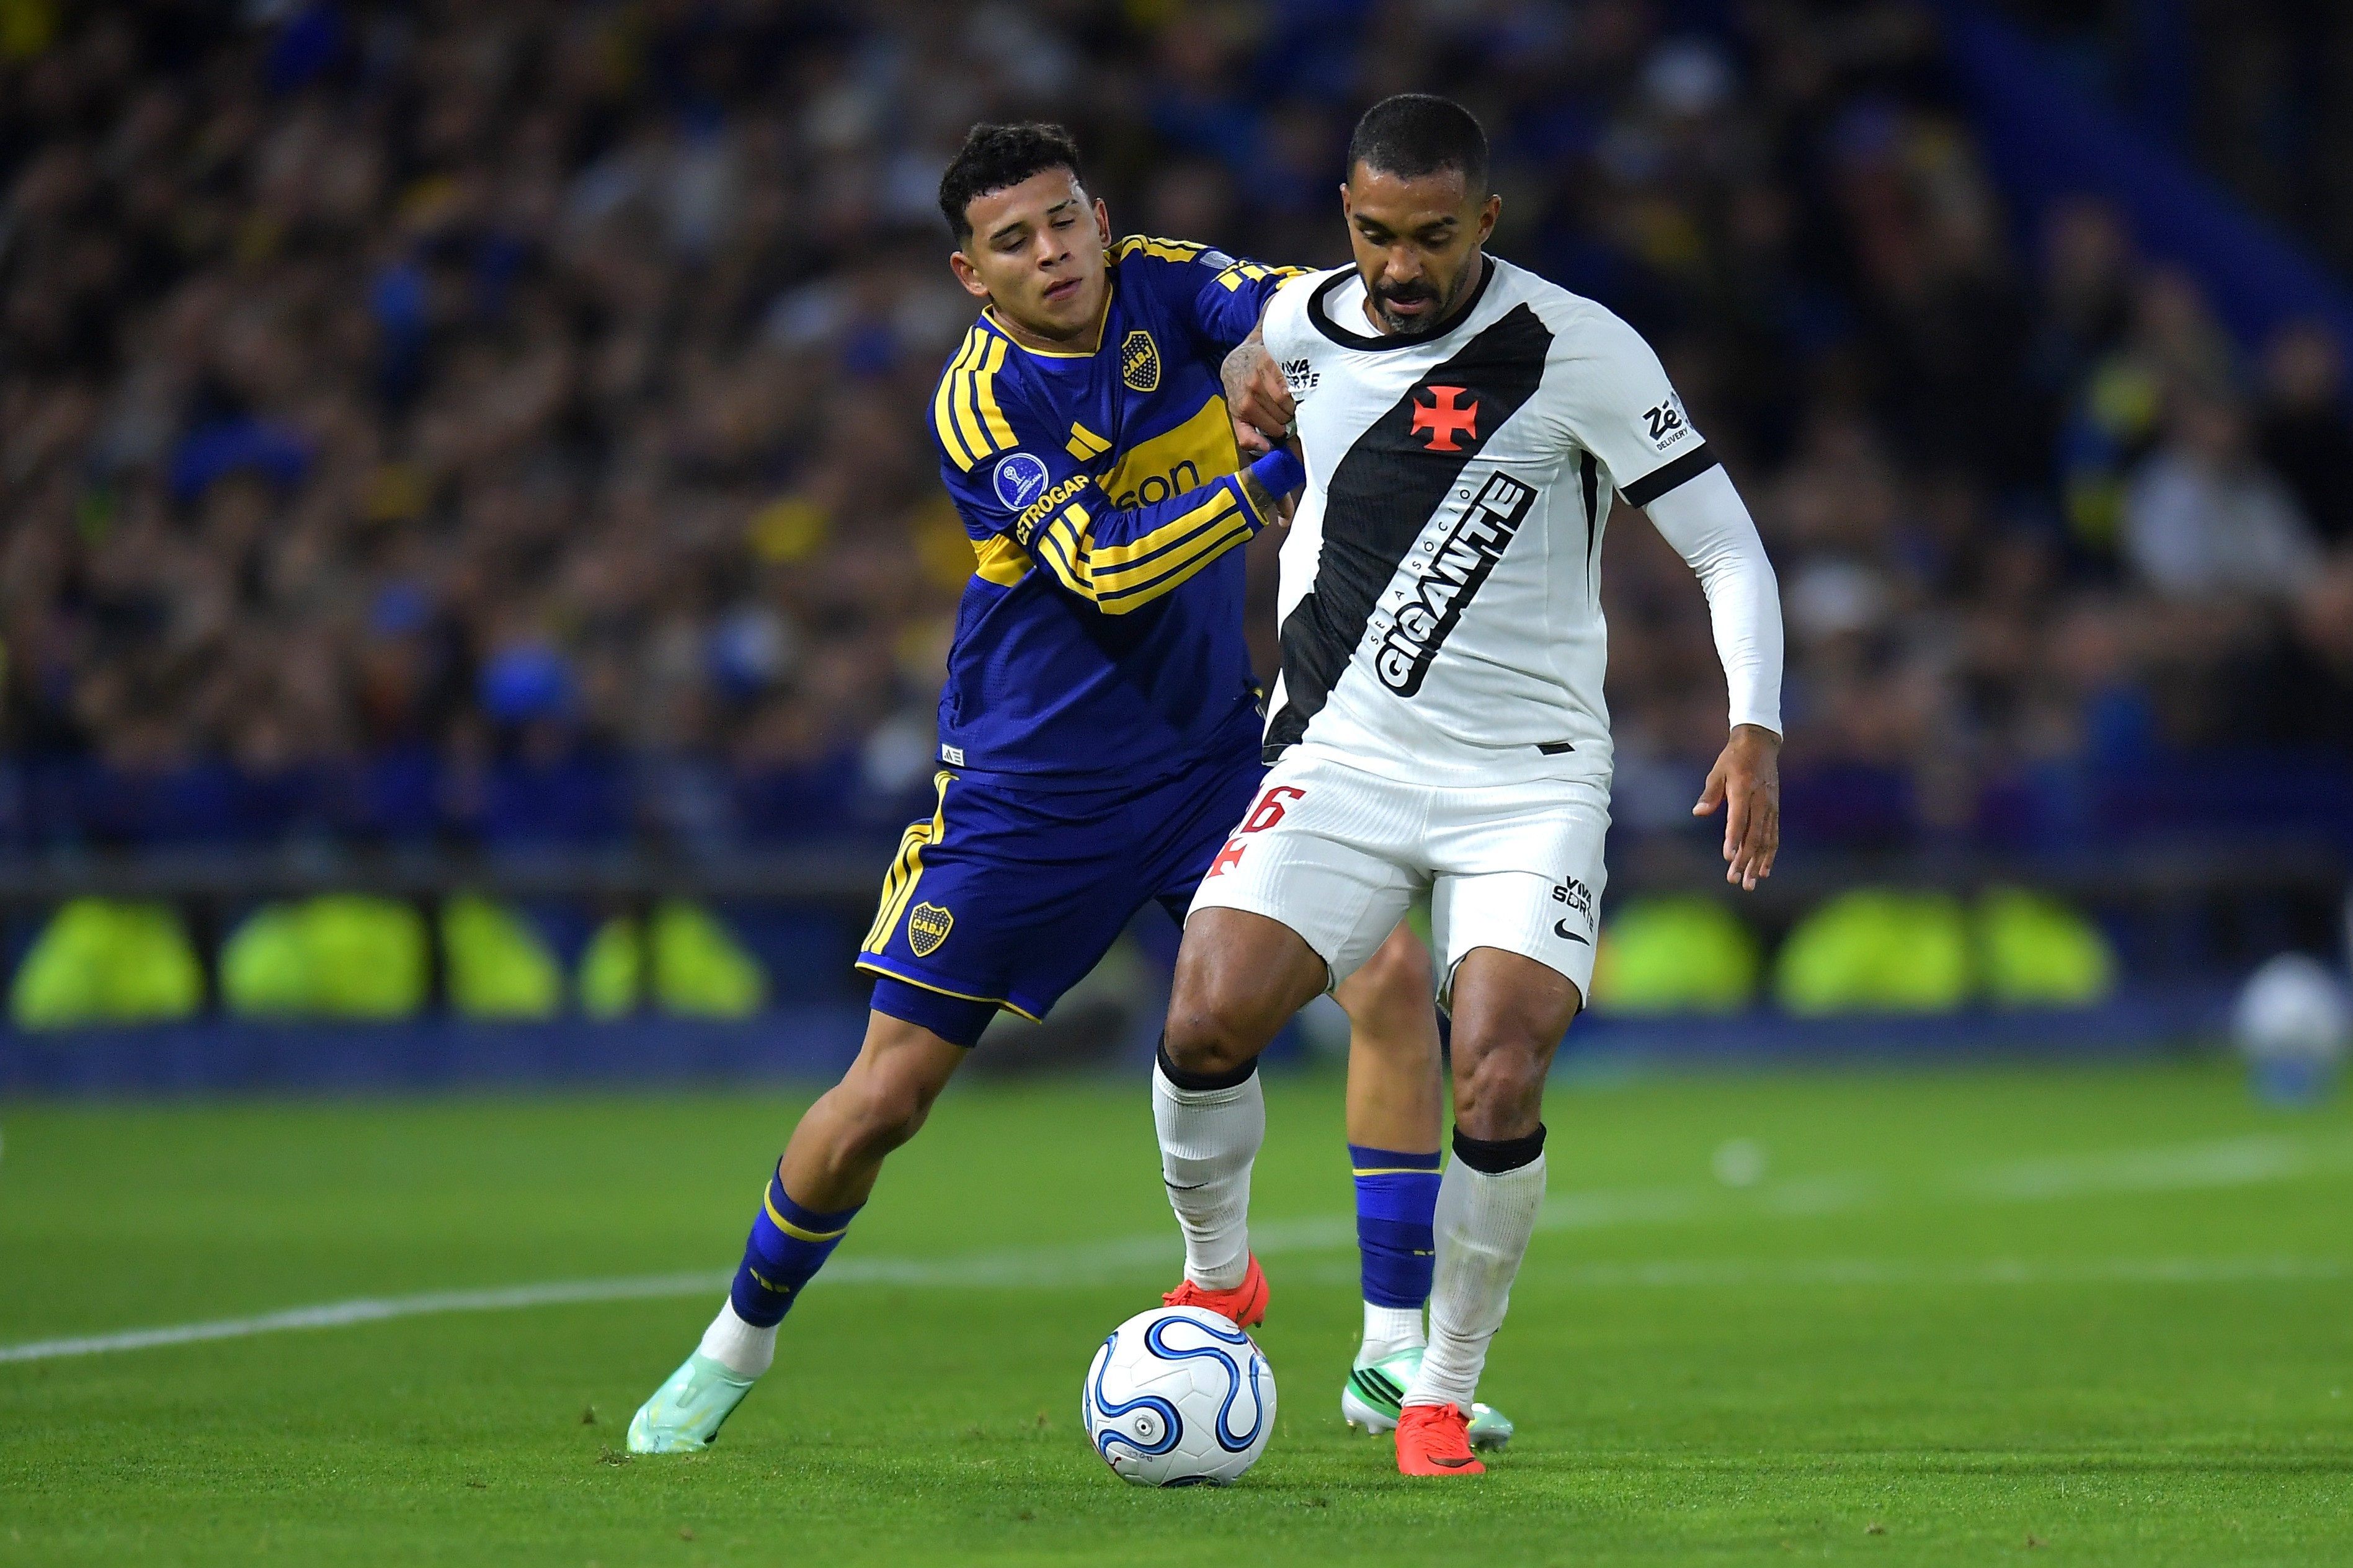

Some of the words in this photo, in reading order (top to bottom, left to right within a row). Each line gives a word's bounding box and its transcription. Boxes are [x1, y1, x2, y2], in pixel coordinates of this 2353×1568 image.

[1123, 345, 1152, 378] CABJ
[1286, 373, 1320, 389] RTE
[1642, 399, 1683, 441] Zé
[1655, 427, 1689, 451] DELIVERY
[1016, 475, 1090, 546] CETROGAR
[1378, 475, 1528, 690] GIGANTE
[1370, 590, 1405, 645] SEA
[1239, 785, 1307, 835] 6
[1552, 885, 1594, 934] SORTE
[1566, 875, 1592, 910] VIVA
[913, 918, 945, 936] CABJ
